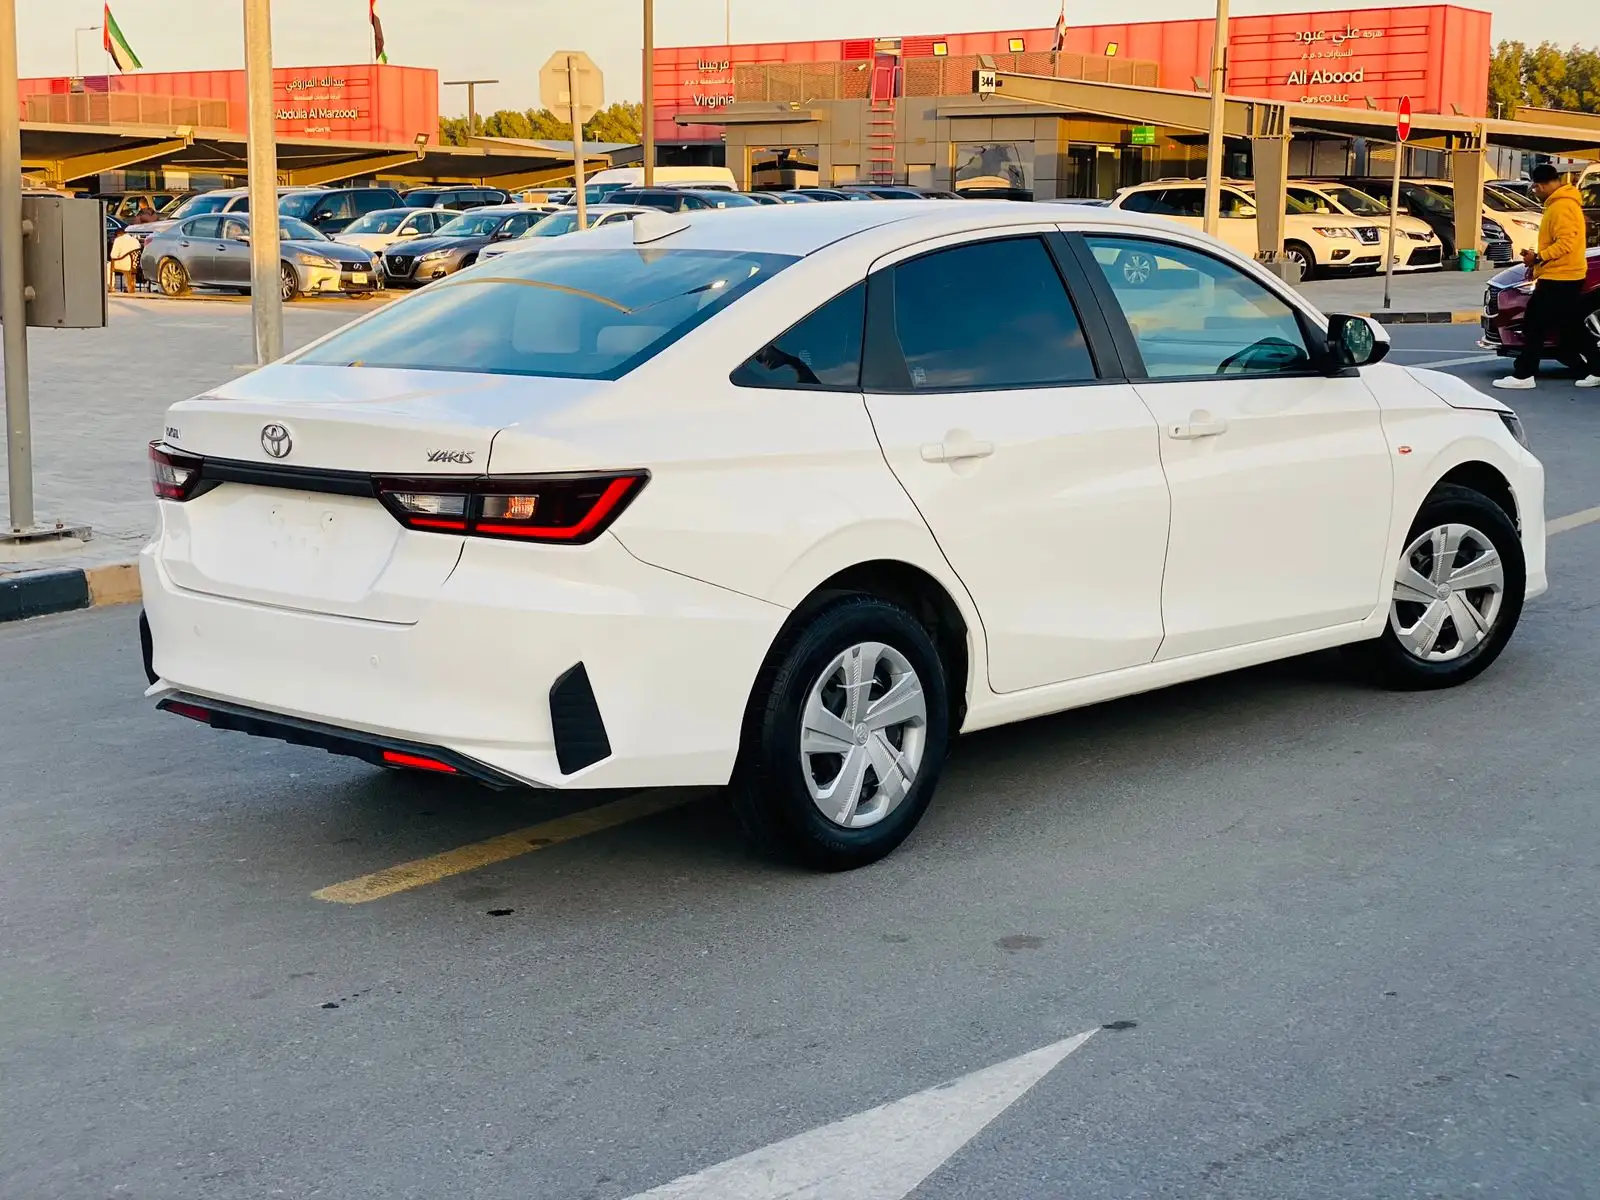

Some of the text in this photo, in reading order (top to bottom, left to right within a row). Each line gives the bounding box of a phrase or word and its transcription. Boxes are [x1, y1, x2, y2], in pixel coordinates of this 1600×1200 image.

[1295, 30, 1326, 45] عبود
[1331, 24, 1360, 46] علي
[981, 76, 994, 87] 344
[1287, 67, 1365, 85] Ali Abood
[693, 93, 736, 109] Virginia
[275, 106, 359, 120] Abdulla Al Marzooqi
[427, 448, 476, 464] YARIS
